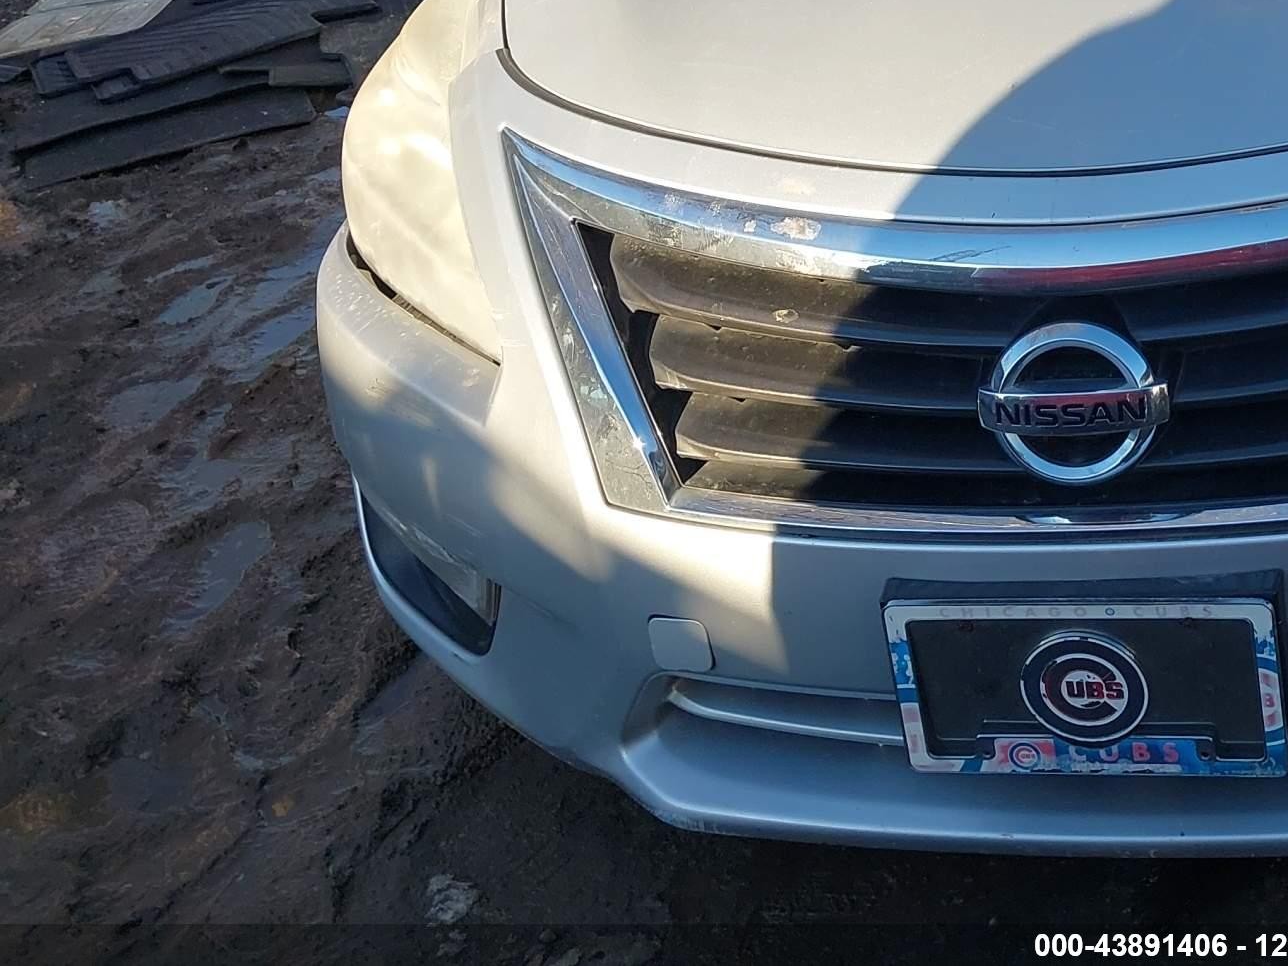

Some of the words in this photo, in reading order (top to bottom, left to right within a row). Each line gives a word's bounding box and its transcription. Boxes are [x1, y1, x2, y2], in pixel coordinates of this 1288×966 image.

[995, 393, 1147, 428] NISSAN
[938, 606, 1088, 618] CHICAGO
[1132, 605, 1214, 617] CUBS
